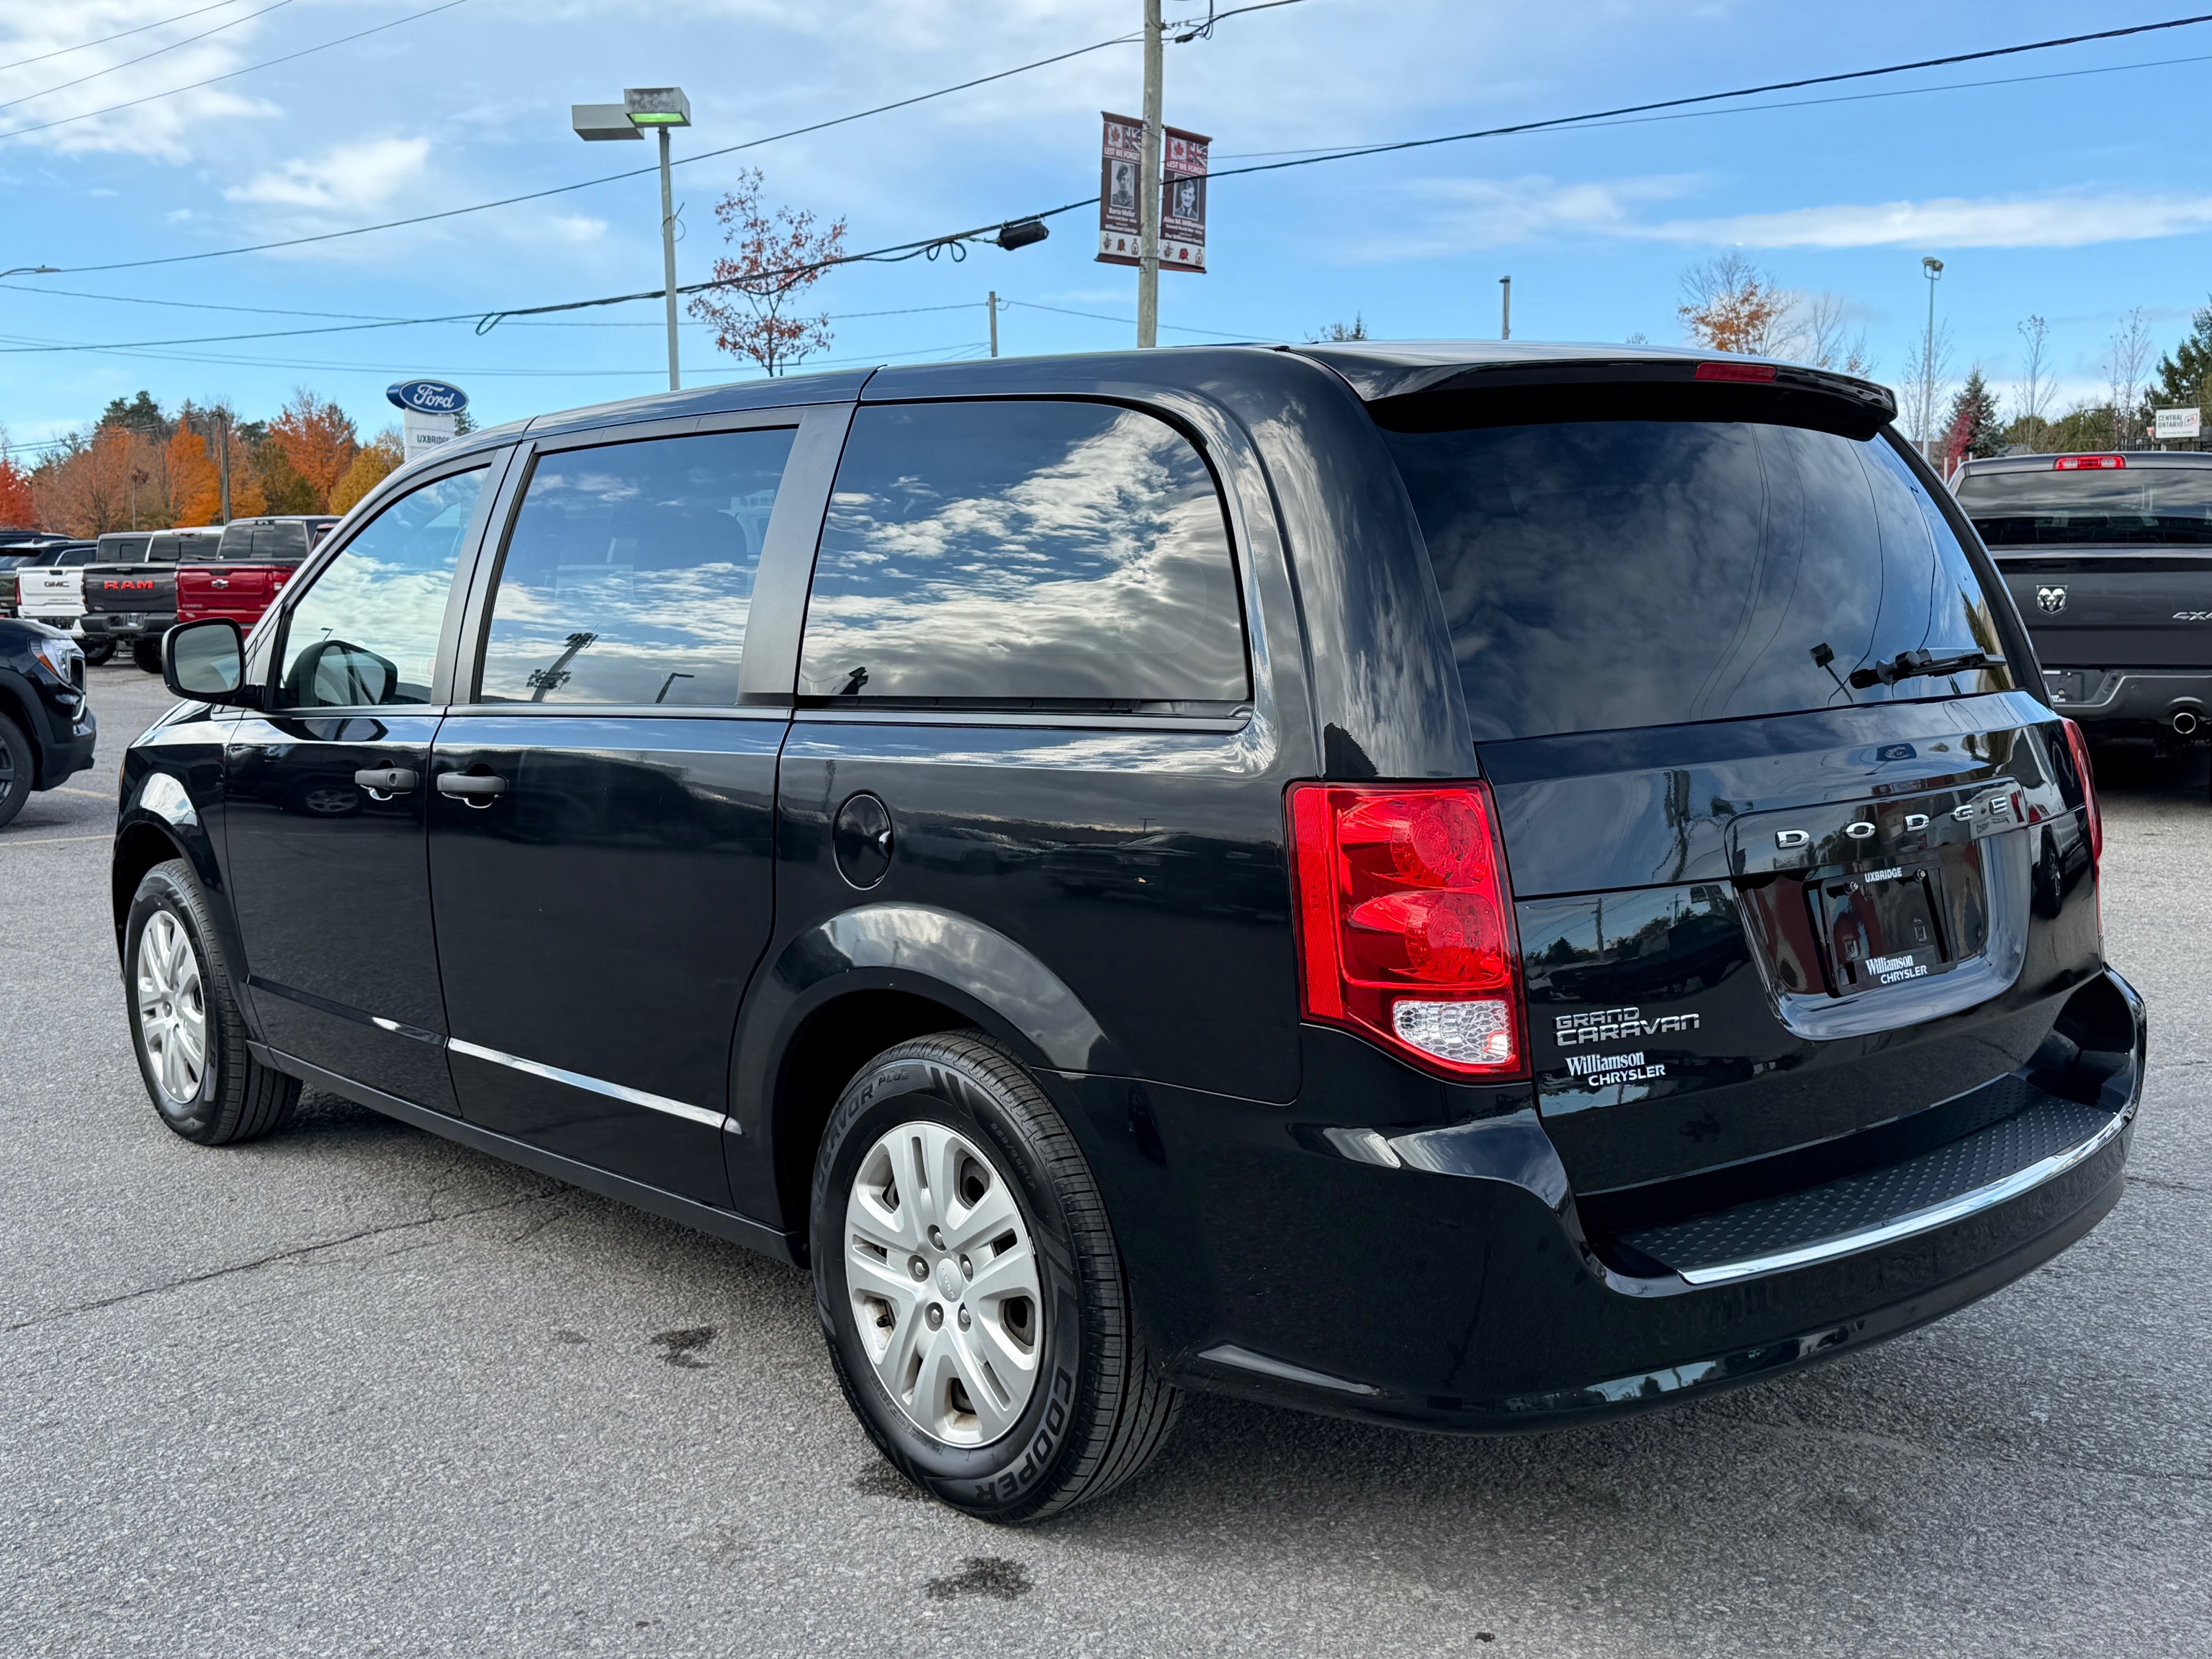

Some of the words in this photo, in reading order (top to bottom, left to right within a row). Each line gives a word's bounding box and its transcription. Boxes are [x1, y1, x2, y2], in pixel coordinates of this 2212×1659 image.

[1104, 146, 1115, 156] LEST
[1124, 150, 1141, 161] FORGET
[1187, 165, 1205, 175] FORGET
[413, 384, 455, 409] Ford
[104, 580, 154, 590] RAM
[1775, 796, 2008, 850] DODGE
[1864, 867, 1902, 884] UXBRIDGE
[1865, 954, 1914, 976] Williamson
[1880, 965, 1928, 984] CHRYSLER
[1554, 1007, 1640, 1030] GRAND
[1555, 1013, 1700, 1046] CARAVAN
[1565, 1051, 1645, 1077] Williamson
[878, 1070, 910, 1087] PLUS
[1588, 1064, 1666, 1087] CHRYSLER
[975, 1365, 1073, 1505] COOPER
